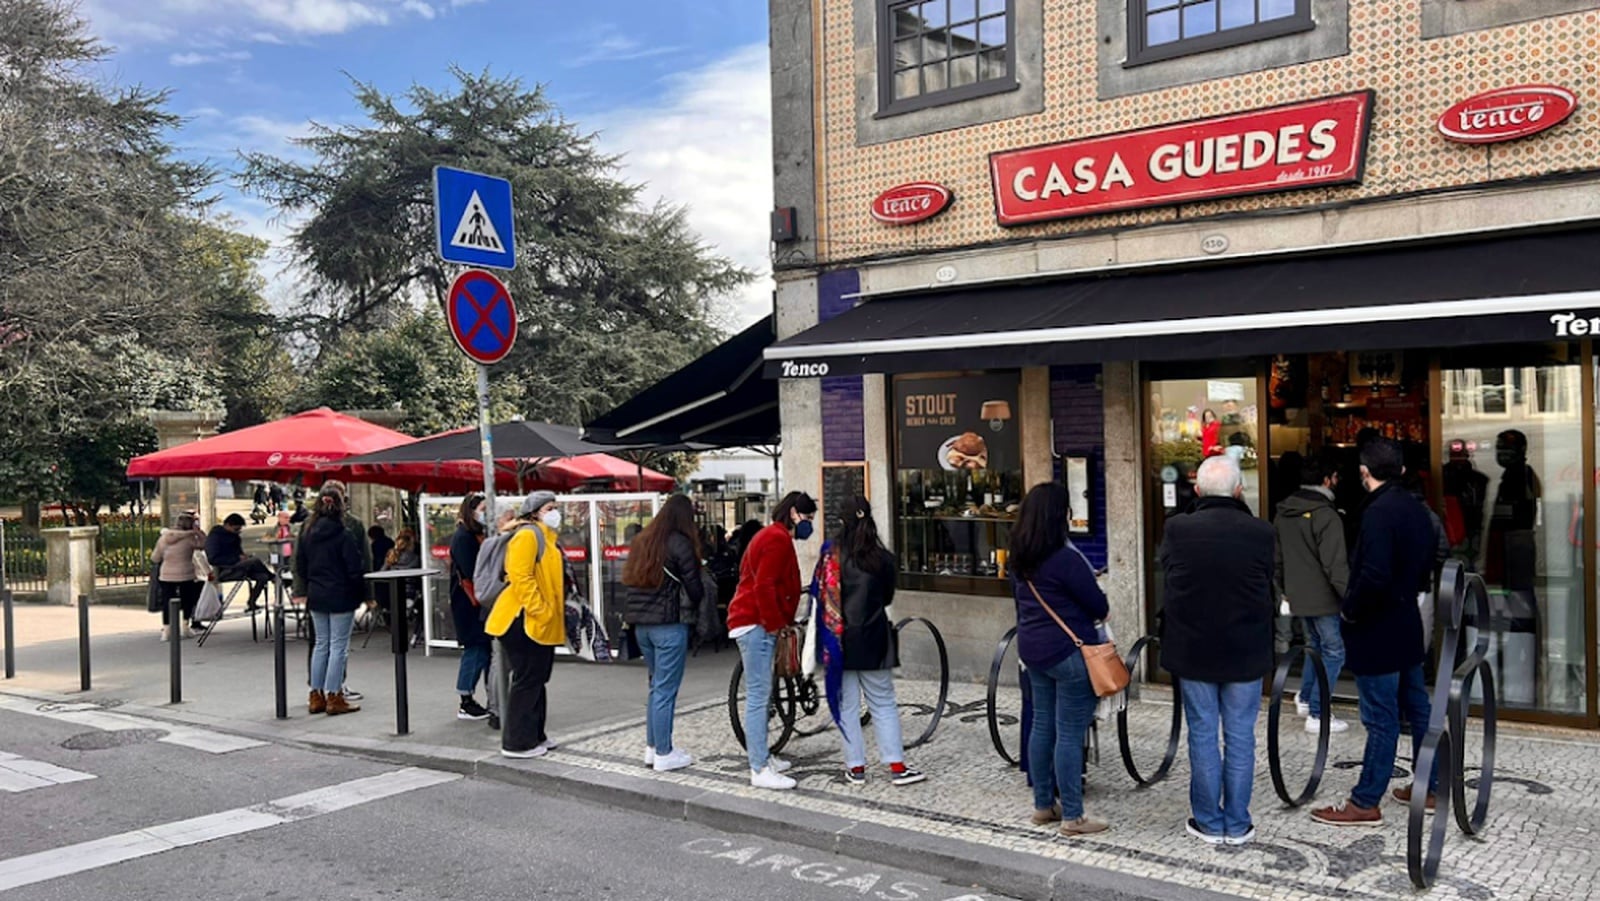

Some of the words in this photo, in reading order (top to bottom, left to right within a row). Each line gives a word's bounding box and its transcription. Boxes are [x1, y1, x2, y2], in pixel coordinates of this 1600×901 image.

[1013, 152, 1135, 201] CASA
[1148, 119, 1338, 182] GUEDES
[781, 360, 829, 377] Tenco
[905, 393, 957, 416] STOUT
